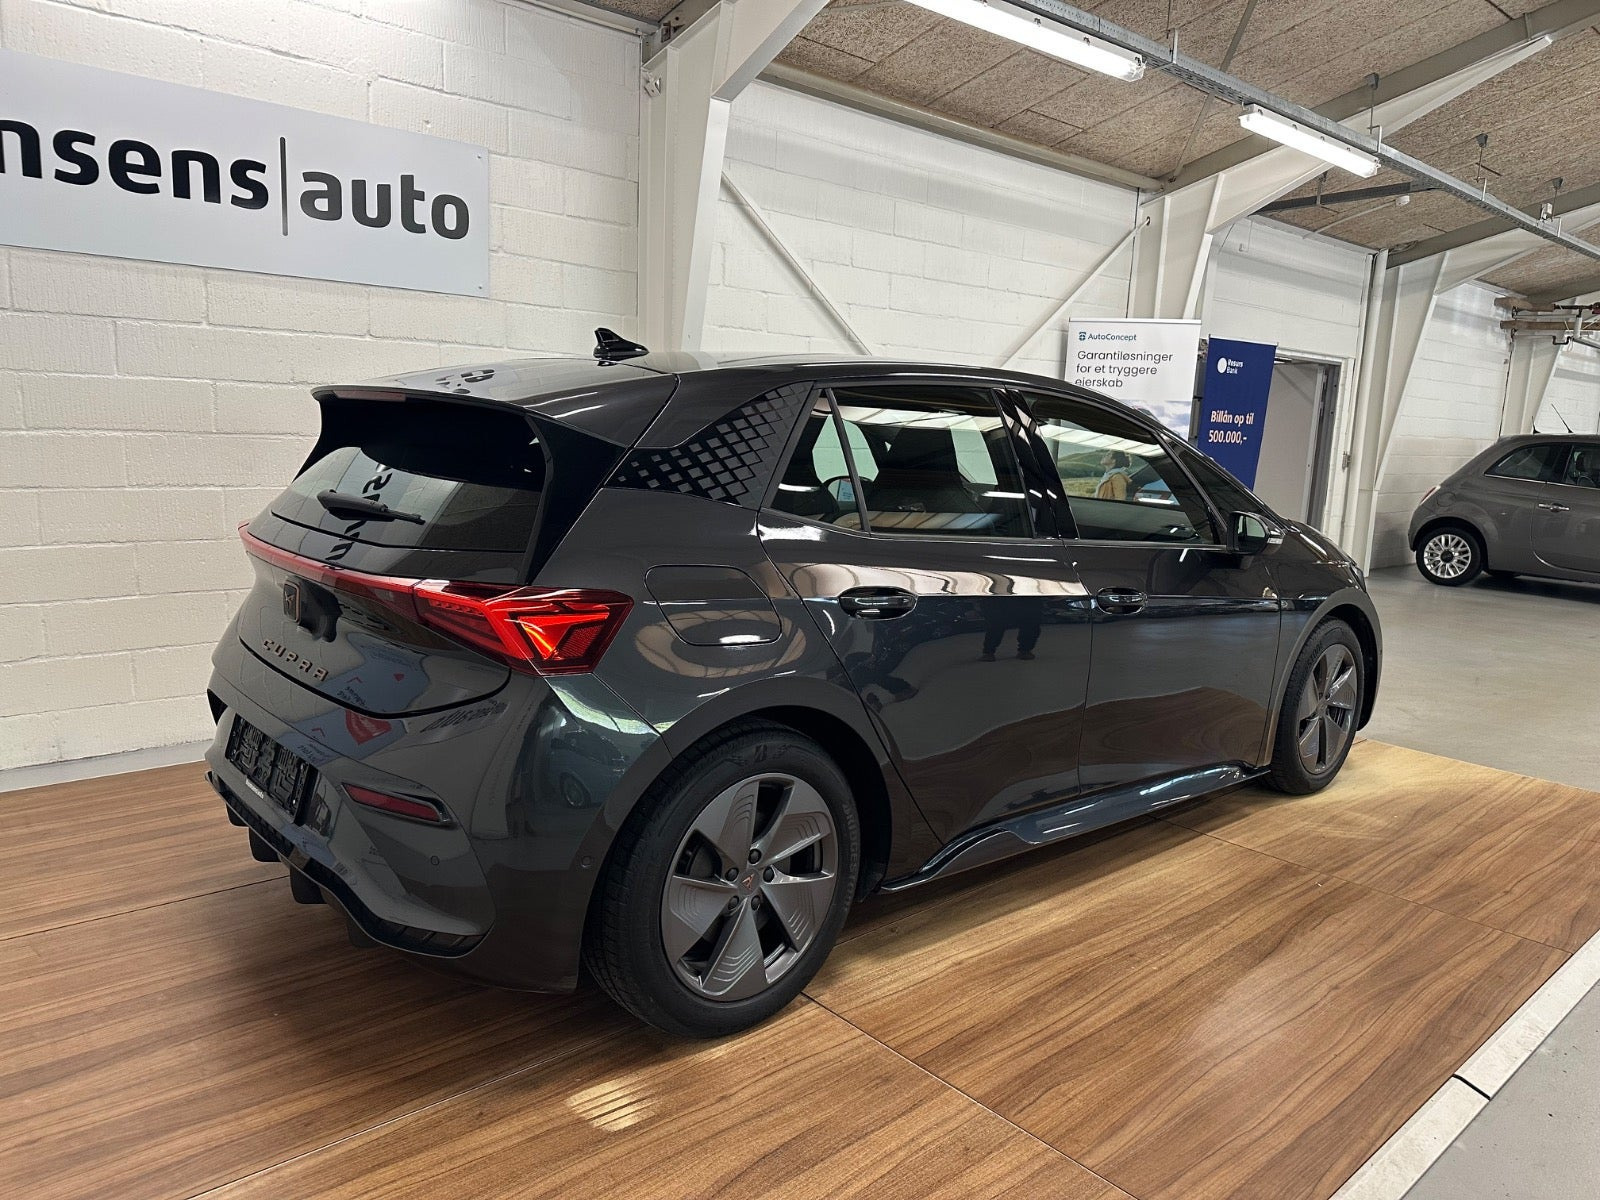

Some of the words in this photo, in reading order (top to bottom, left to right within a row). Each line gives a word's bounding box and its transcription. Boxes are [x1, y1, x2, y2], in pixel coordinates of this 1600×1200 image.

[300, 171, 469, 240] auto
[1088, 333, 1137, 342] AutoConcept
[1077, 350, 1173, 365] Garantiløsninger
[1076, 363, 1092, 374] for
[1094, 365, 1107, 374] et
[1109, 365, 1158, 378] tryggere
[1074, 376, 1123, 388] eierskab
[1210, 410, 1233, 424] Billån
[1233, 414, 1245, 427] op
[1245, 412, 1254, 425] til
[1208, 429, 1248, 446] 500.000,-
[263, 639, 329, 682] CUPRA
